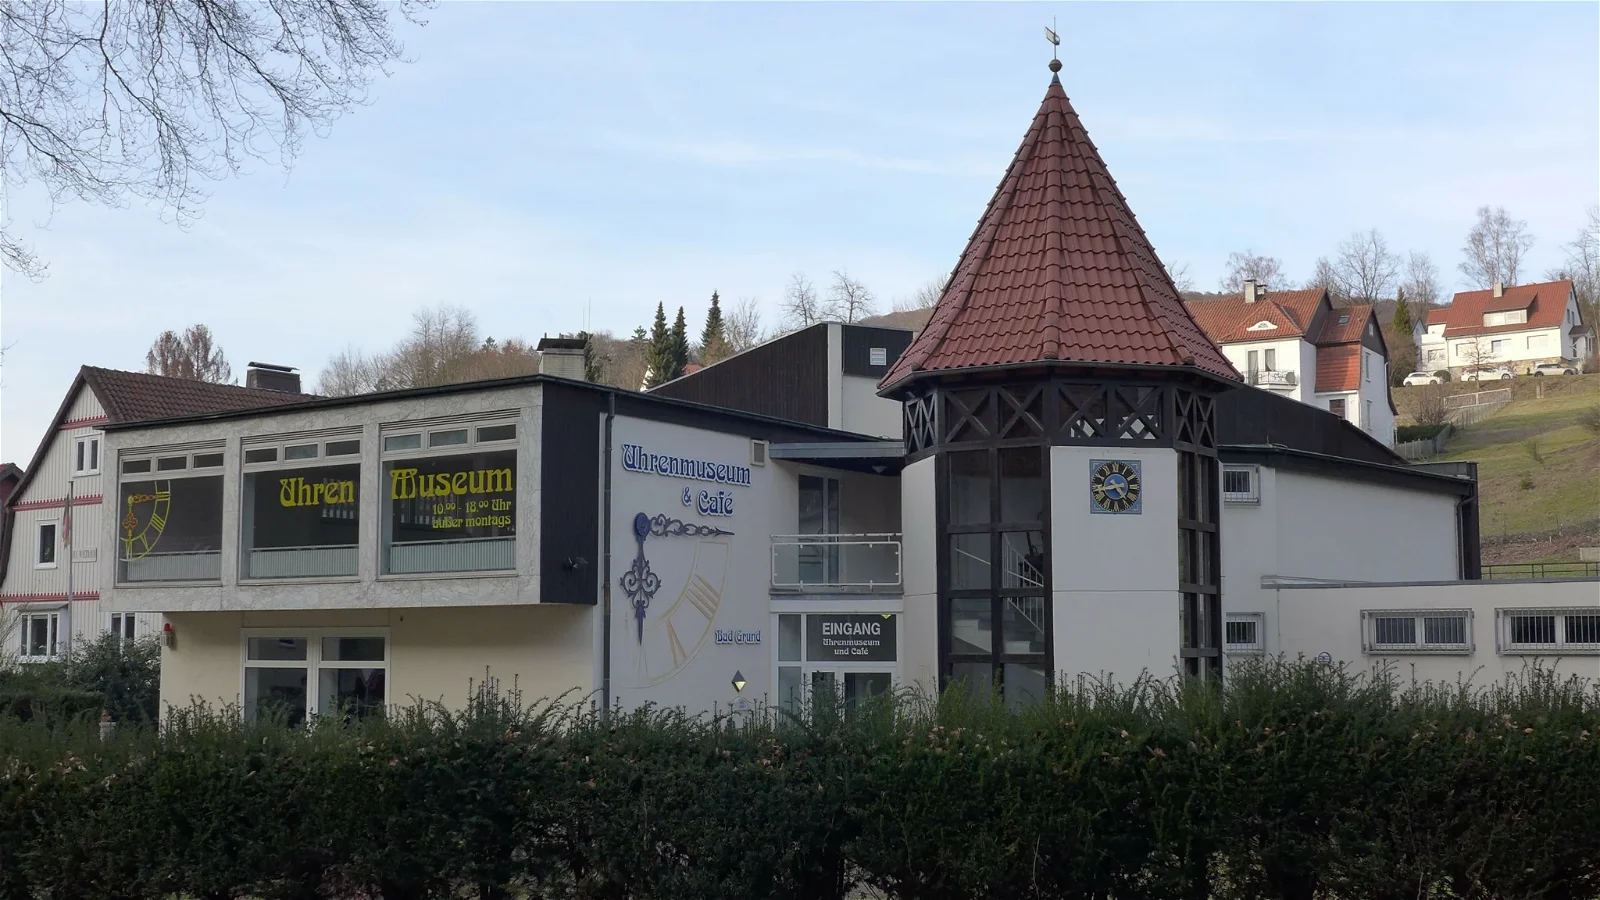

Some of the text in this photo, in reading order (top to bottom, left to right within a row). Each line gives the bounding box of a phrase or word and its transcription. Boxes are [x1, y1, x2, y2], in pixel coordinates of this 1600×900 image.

[622, 443, 751, 486] Uhrenmuseum
[280, 468, 513, 507] Uhren Museum
[491, 498, 512, 511] Uhr
[682, 486, 733, 516] & Café
[432, 514, 511, 529] außer montags
[822, 622, 881, 635] EINGANG
[715, 629, 761, 645] Bad Grund
[822, 638, 880, 646] Uhrenmuseum
[834, 647, 869, 655] und Café
